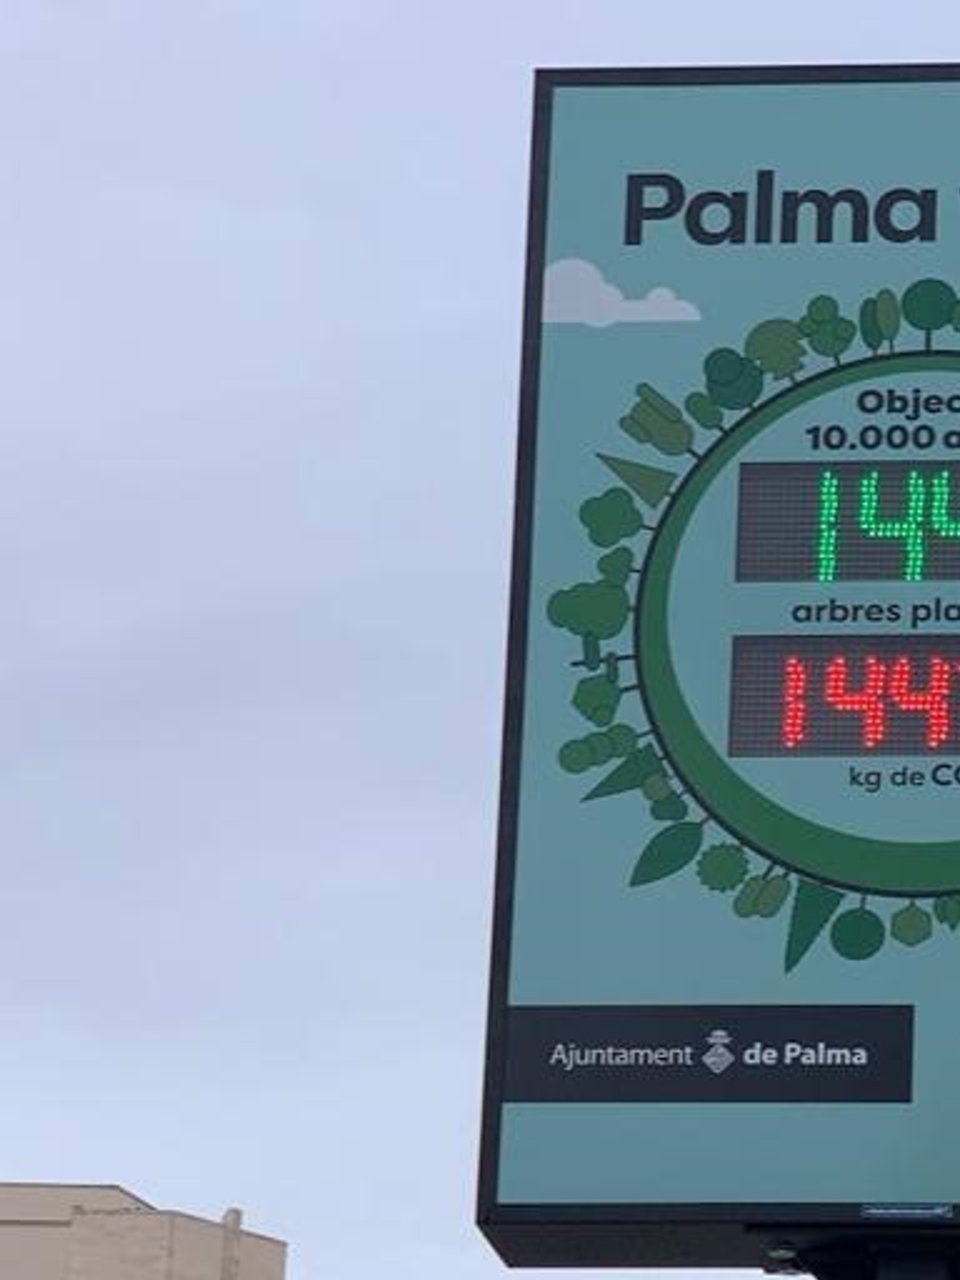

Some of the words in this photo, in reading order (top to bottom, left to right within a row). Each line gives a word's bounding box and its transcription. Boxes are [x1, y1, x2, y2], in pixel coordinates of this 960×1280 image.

[623, 169, 937, 245] Palma
[806, 425, 936, 451] 10.000
[791, 599, 901, 623] arbres
[849, 766, 882, 793] kg
[890, 766, 925, 786] de
[550, 1043, 694, 1071] Ajuntament
[743, 1042, 776, 1065] de
[784, 1042, 868, 1065] Palma
